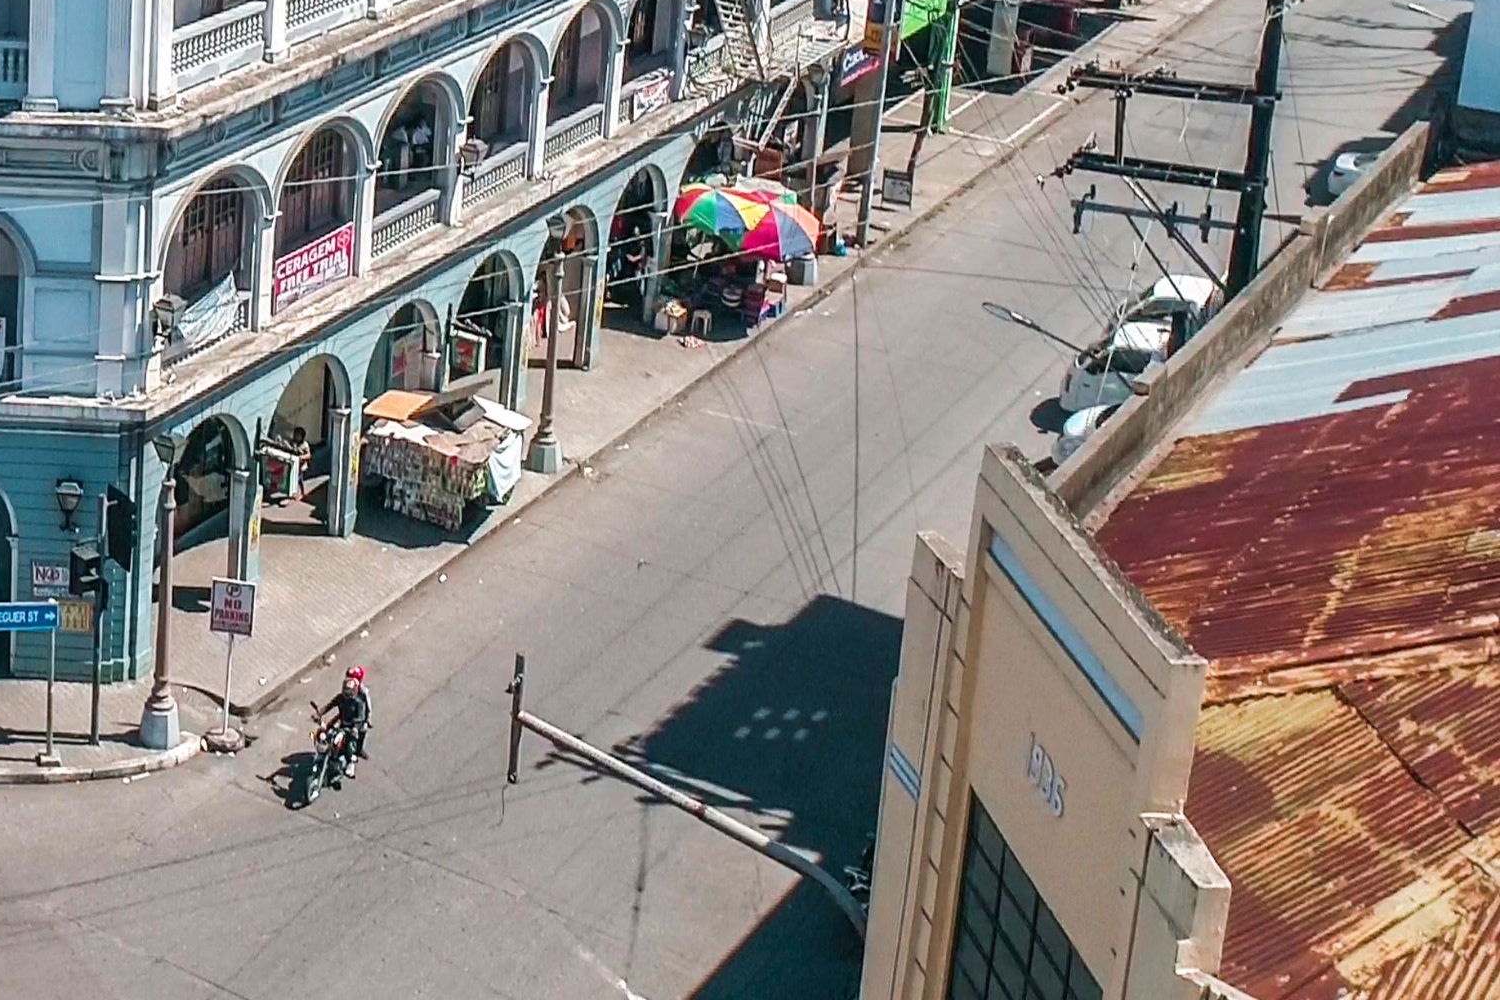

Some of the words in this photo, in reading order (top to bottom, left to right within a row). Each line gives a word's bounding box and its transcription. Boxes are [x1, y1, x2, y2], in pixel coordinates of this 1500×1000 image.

[277, 236, 336, 279] CERAGEM
[280, 267, 311, 293] FREE
[224, 598, 242, 610] NO
[28, 610, 39, 622] ST
